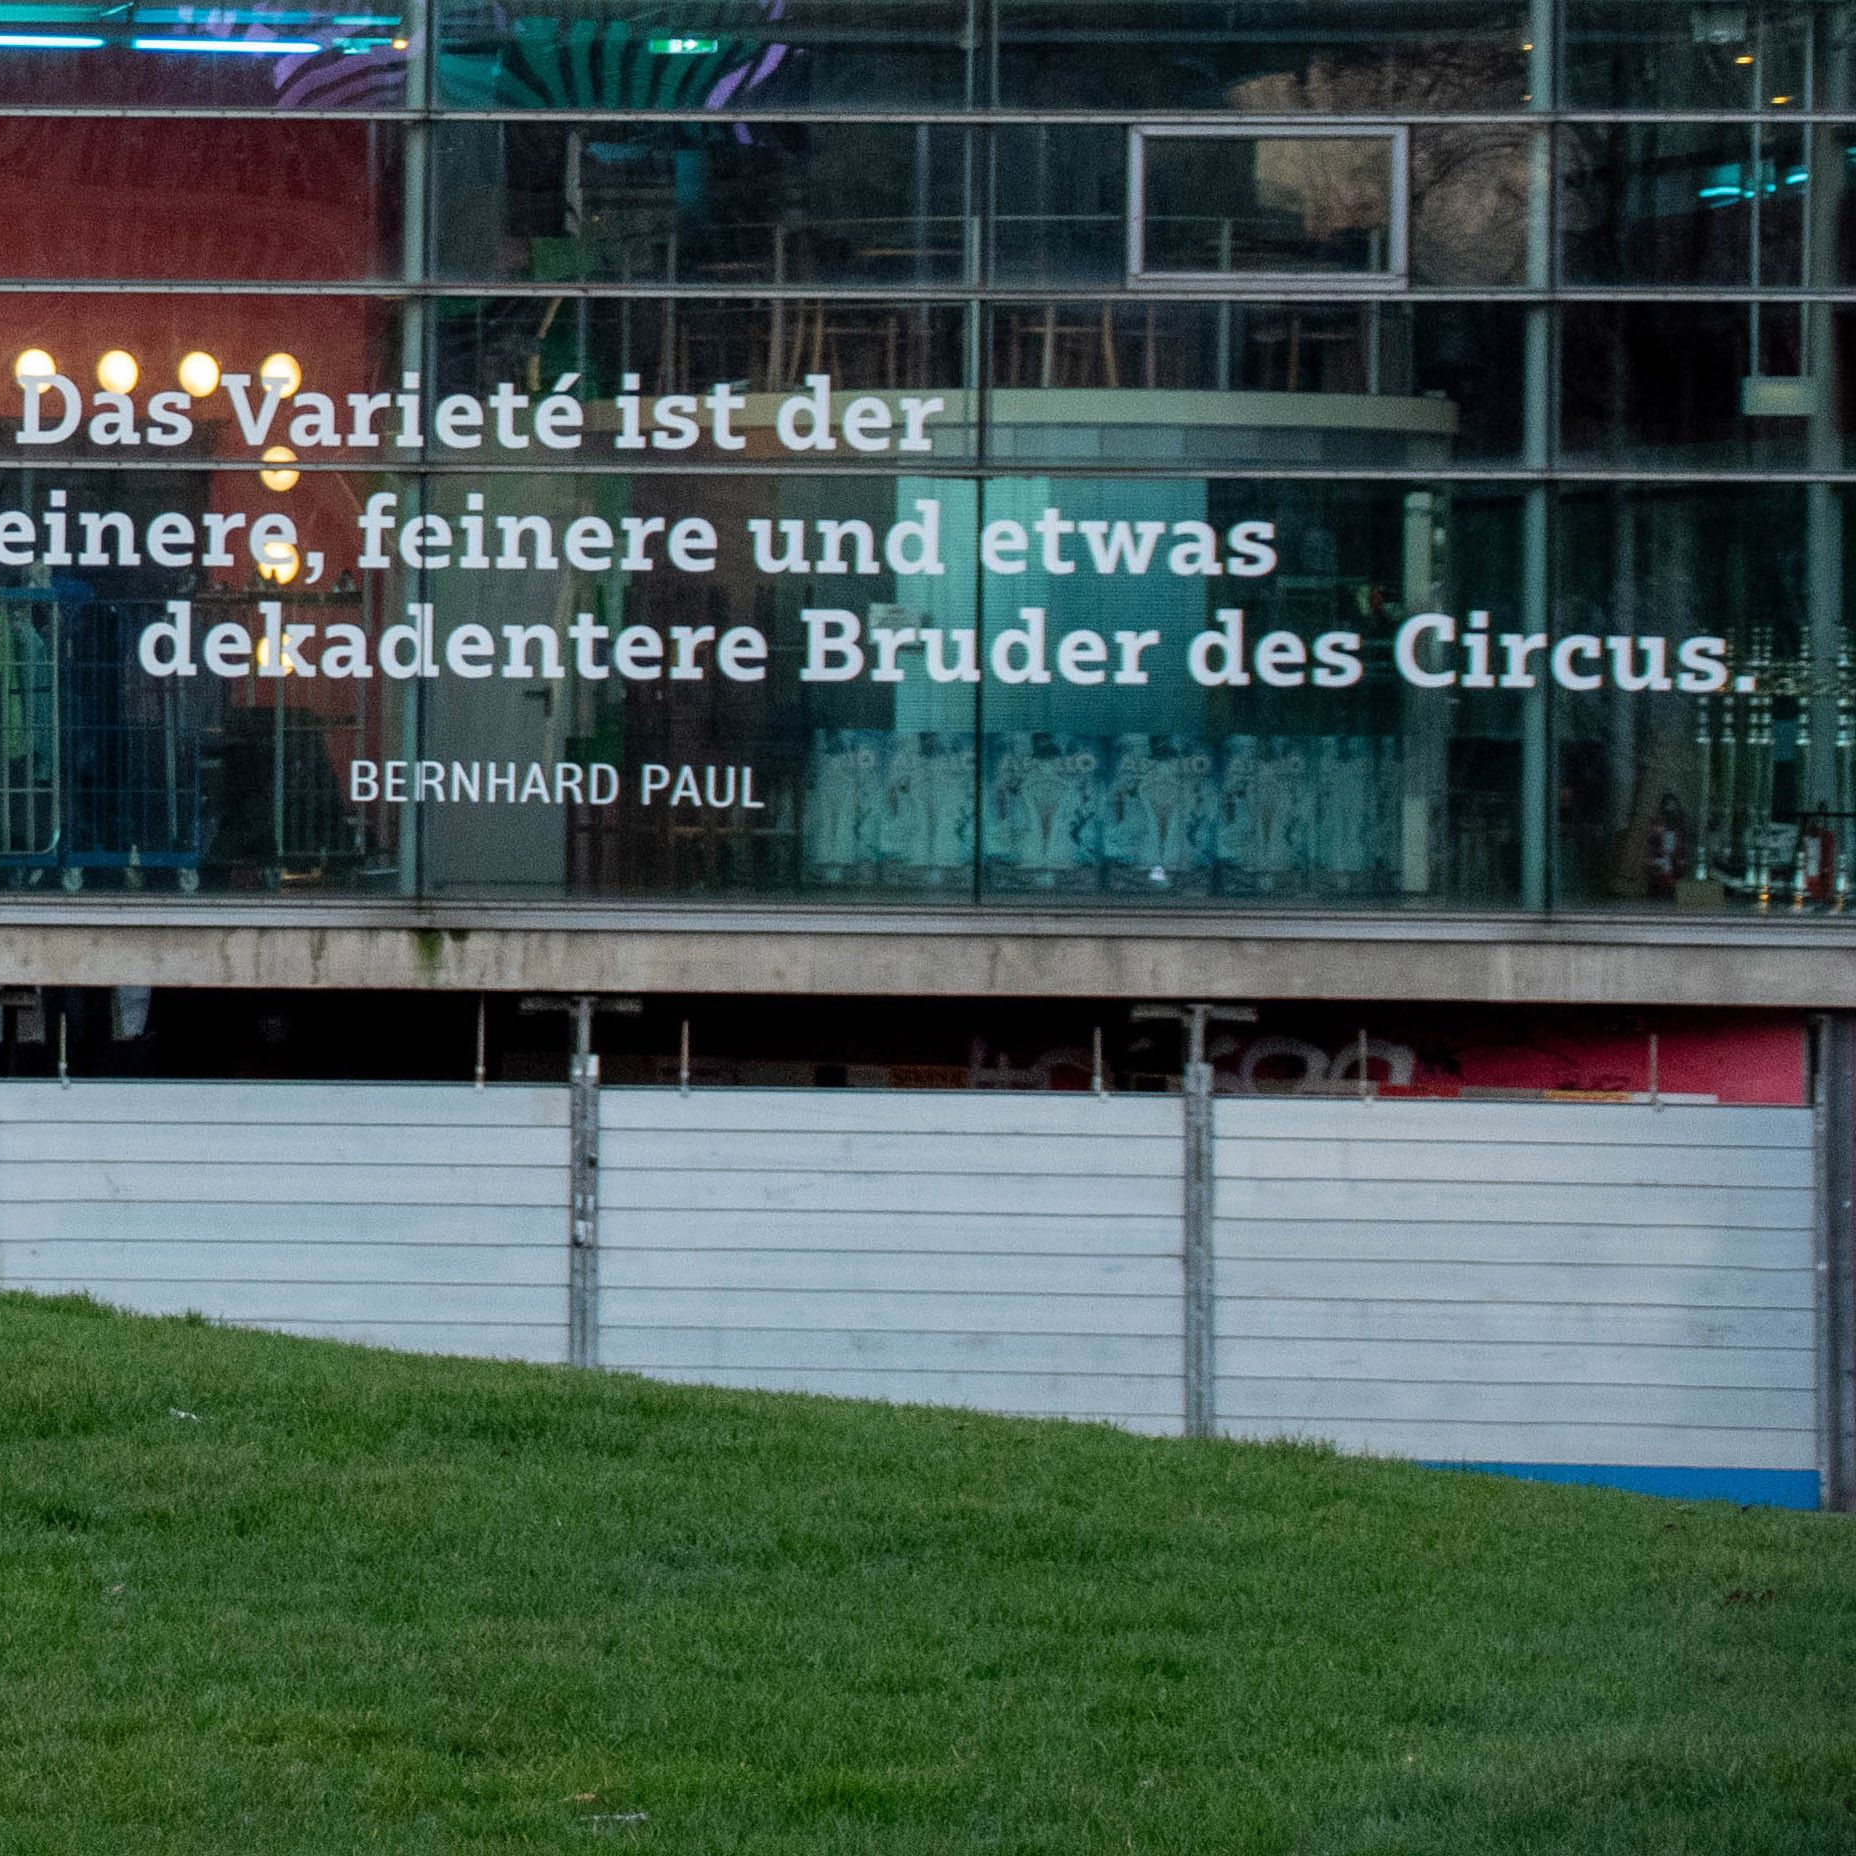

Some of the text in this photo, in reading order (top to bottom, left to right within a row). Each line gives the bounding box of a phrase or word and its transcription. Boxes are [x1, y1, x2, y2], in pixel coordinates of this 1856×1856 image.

[16, 373, 947, 453] Das Varieté ist der
[358, 493, 718, 572] feinere
[749, 498, 946, 576] und
[981, 507, 1276, 576] etwas
[140, 601, 1755, 693] dekadentere Bruder des Circus.
[351, 760, 764, 808] BERNHARD PAUL
